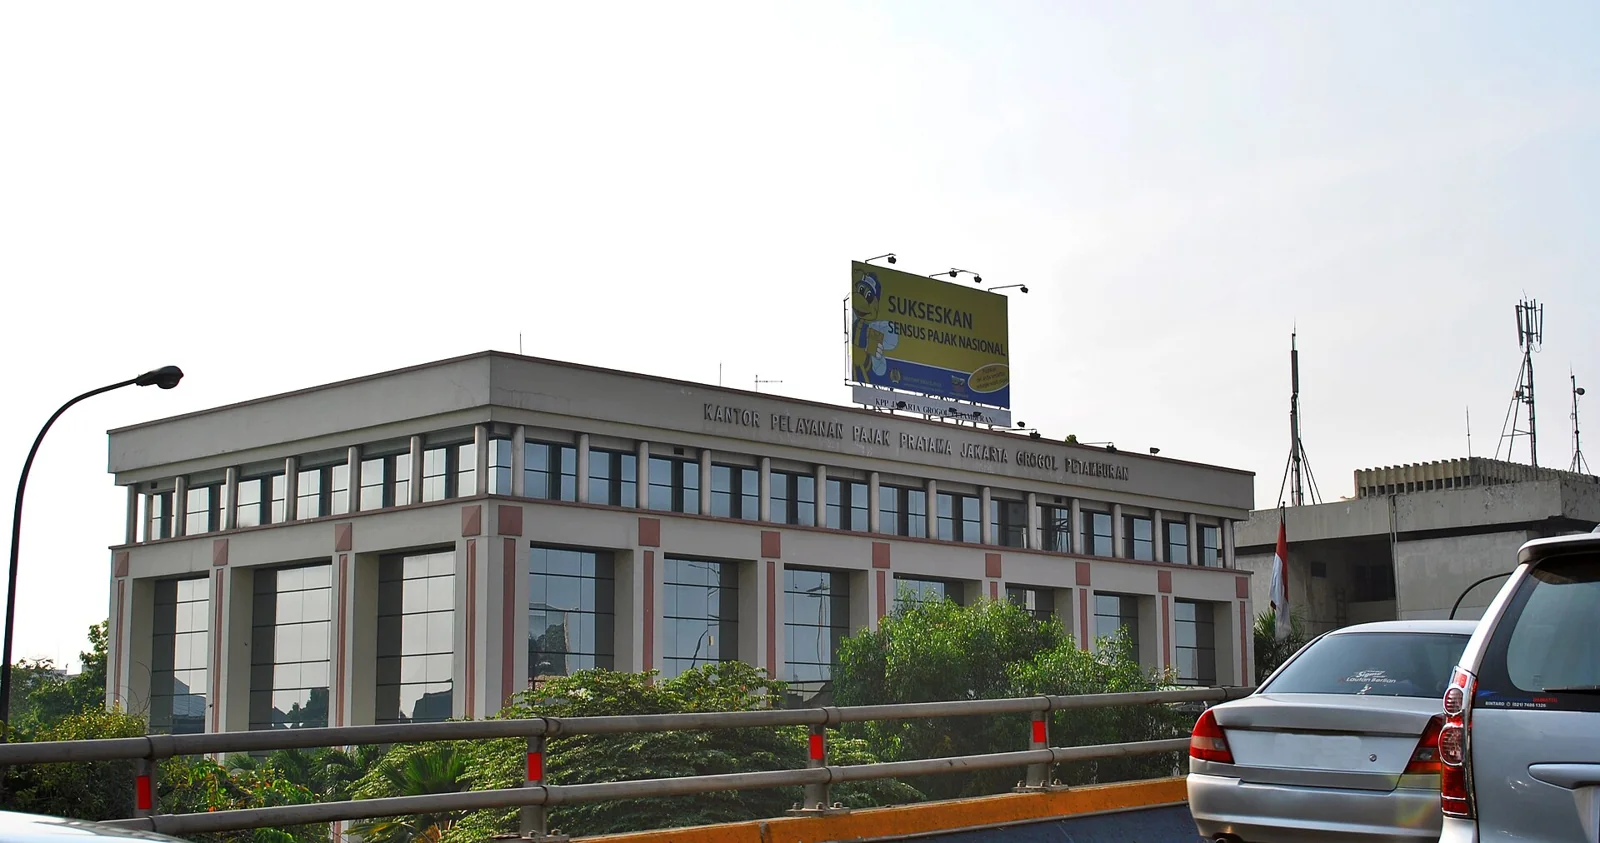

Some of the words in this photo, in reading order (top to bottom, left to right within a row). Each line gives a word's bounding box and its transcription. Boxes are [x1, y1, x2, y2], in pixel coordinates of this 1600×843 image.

[888, 295, 973, 330] SUKSESKAN
[888, 320, 926, 341] SENSUS
[927, 328, 957, 347] PAJAK
[958, 335, 1006, 357] NASIONAL
[875, 398, 889, 407] KPP
[703, 403, 760, 428] KANTOR
[770, 413, 844, 440] PELAYANAN
[852, 425, 890, 446] PAJAK
[899, 432, 952, 455] PRATAMA
[960, 442, 1008, 464] JAKARTA
[1016, 450, 1058, 471] GROGOL
[1064, 458, 1129, 481] PETAMBURAN
